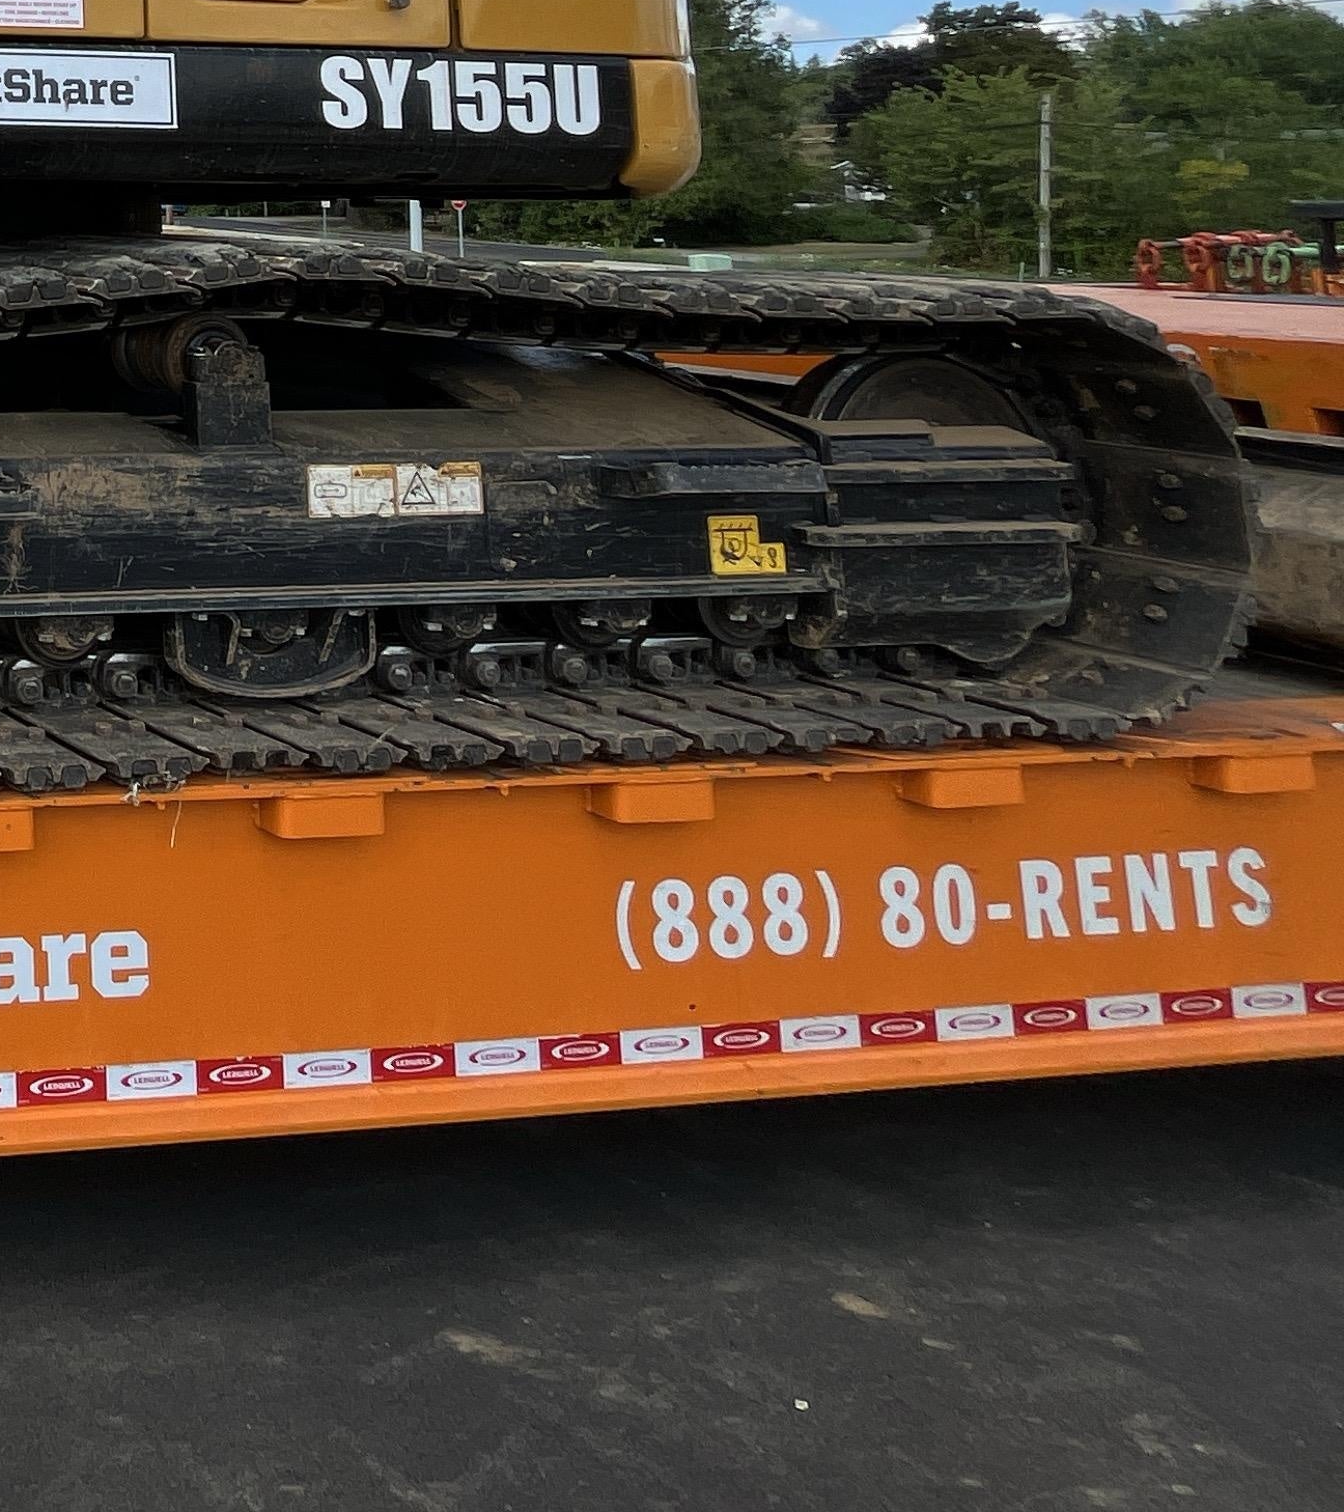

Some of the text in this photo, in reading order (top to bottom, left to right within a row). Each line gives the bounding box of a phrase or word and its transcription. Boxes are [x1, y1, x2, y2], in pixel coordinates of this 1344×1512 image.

[320, 55, 600, 136] SY155U
[616, 847, 1271, 970] (888) 80-RENTS
[42, 1078, 82, 1091] LEDWELL
[133, 1073, 171, 1085] LEDWELL
